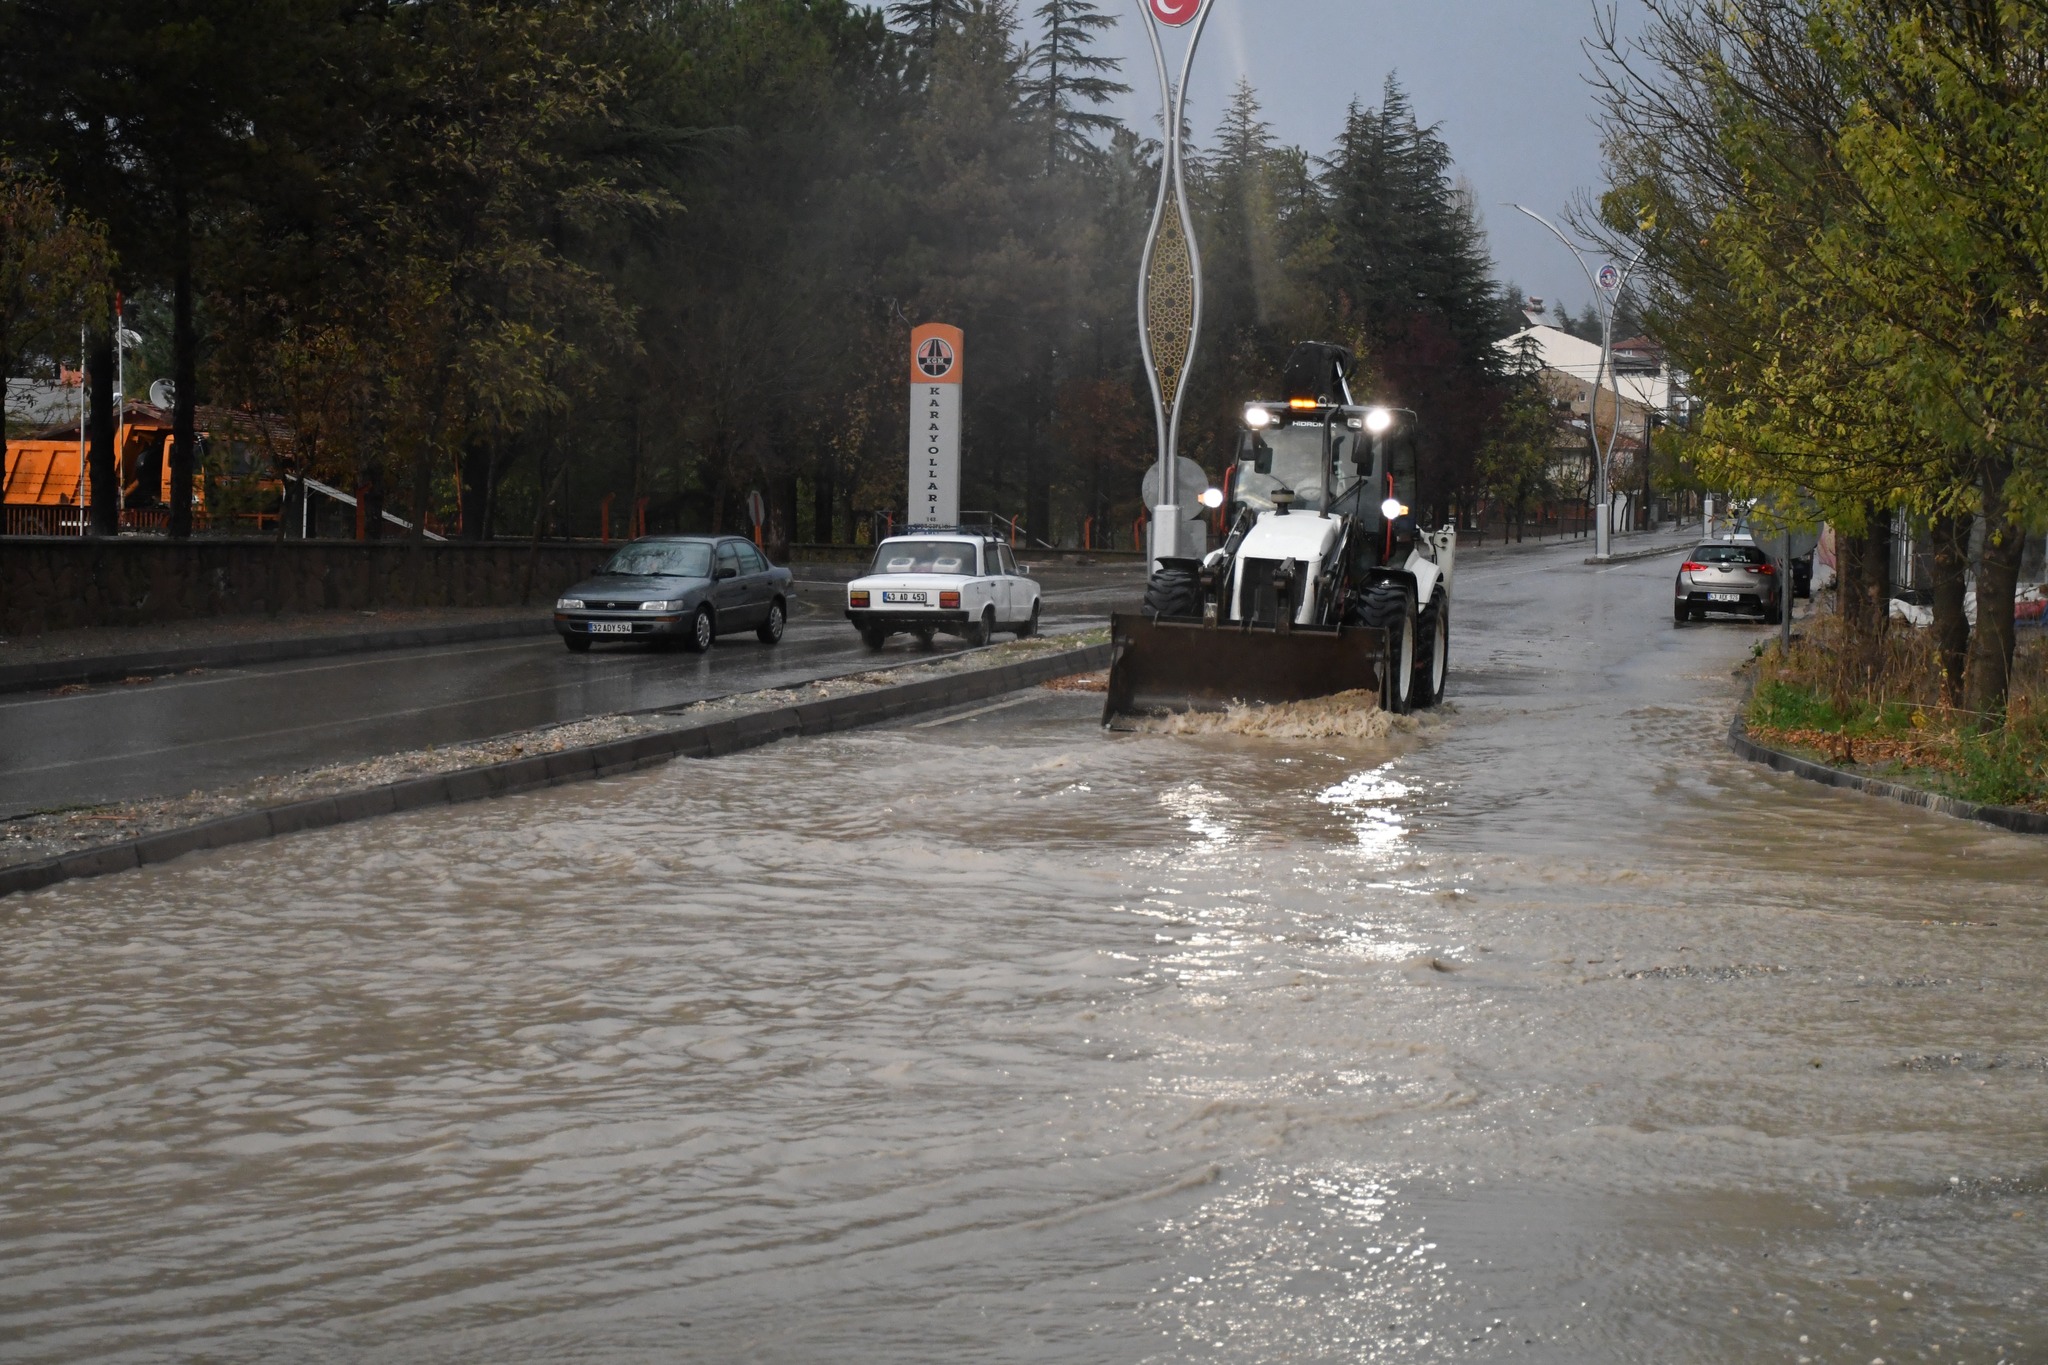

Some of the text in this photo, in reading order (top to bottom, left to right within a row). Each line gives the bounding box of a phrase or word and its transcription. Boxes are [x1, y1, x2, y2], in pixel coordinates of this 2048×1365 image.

[927, 387, 940, 514] KARAYOLLARI
[887, 593, 925, 601] 43 AD 453
[593, 624, 631, 632] 32 ADY 594
